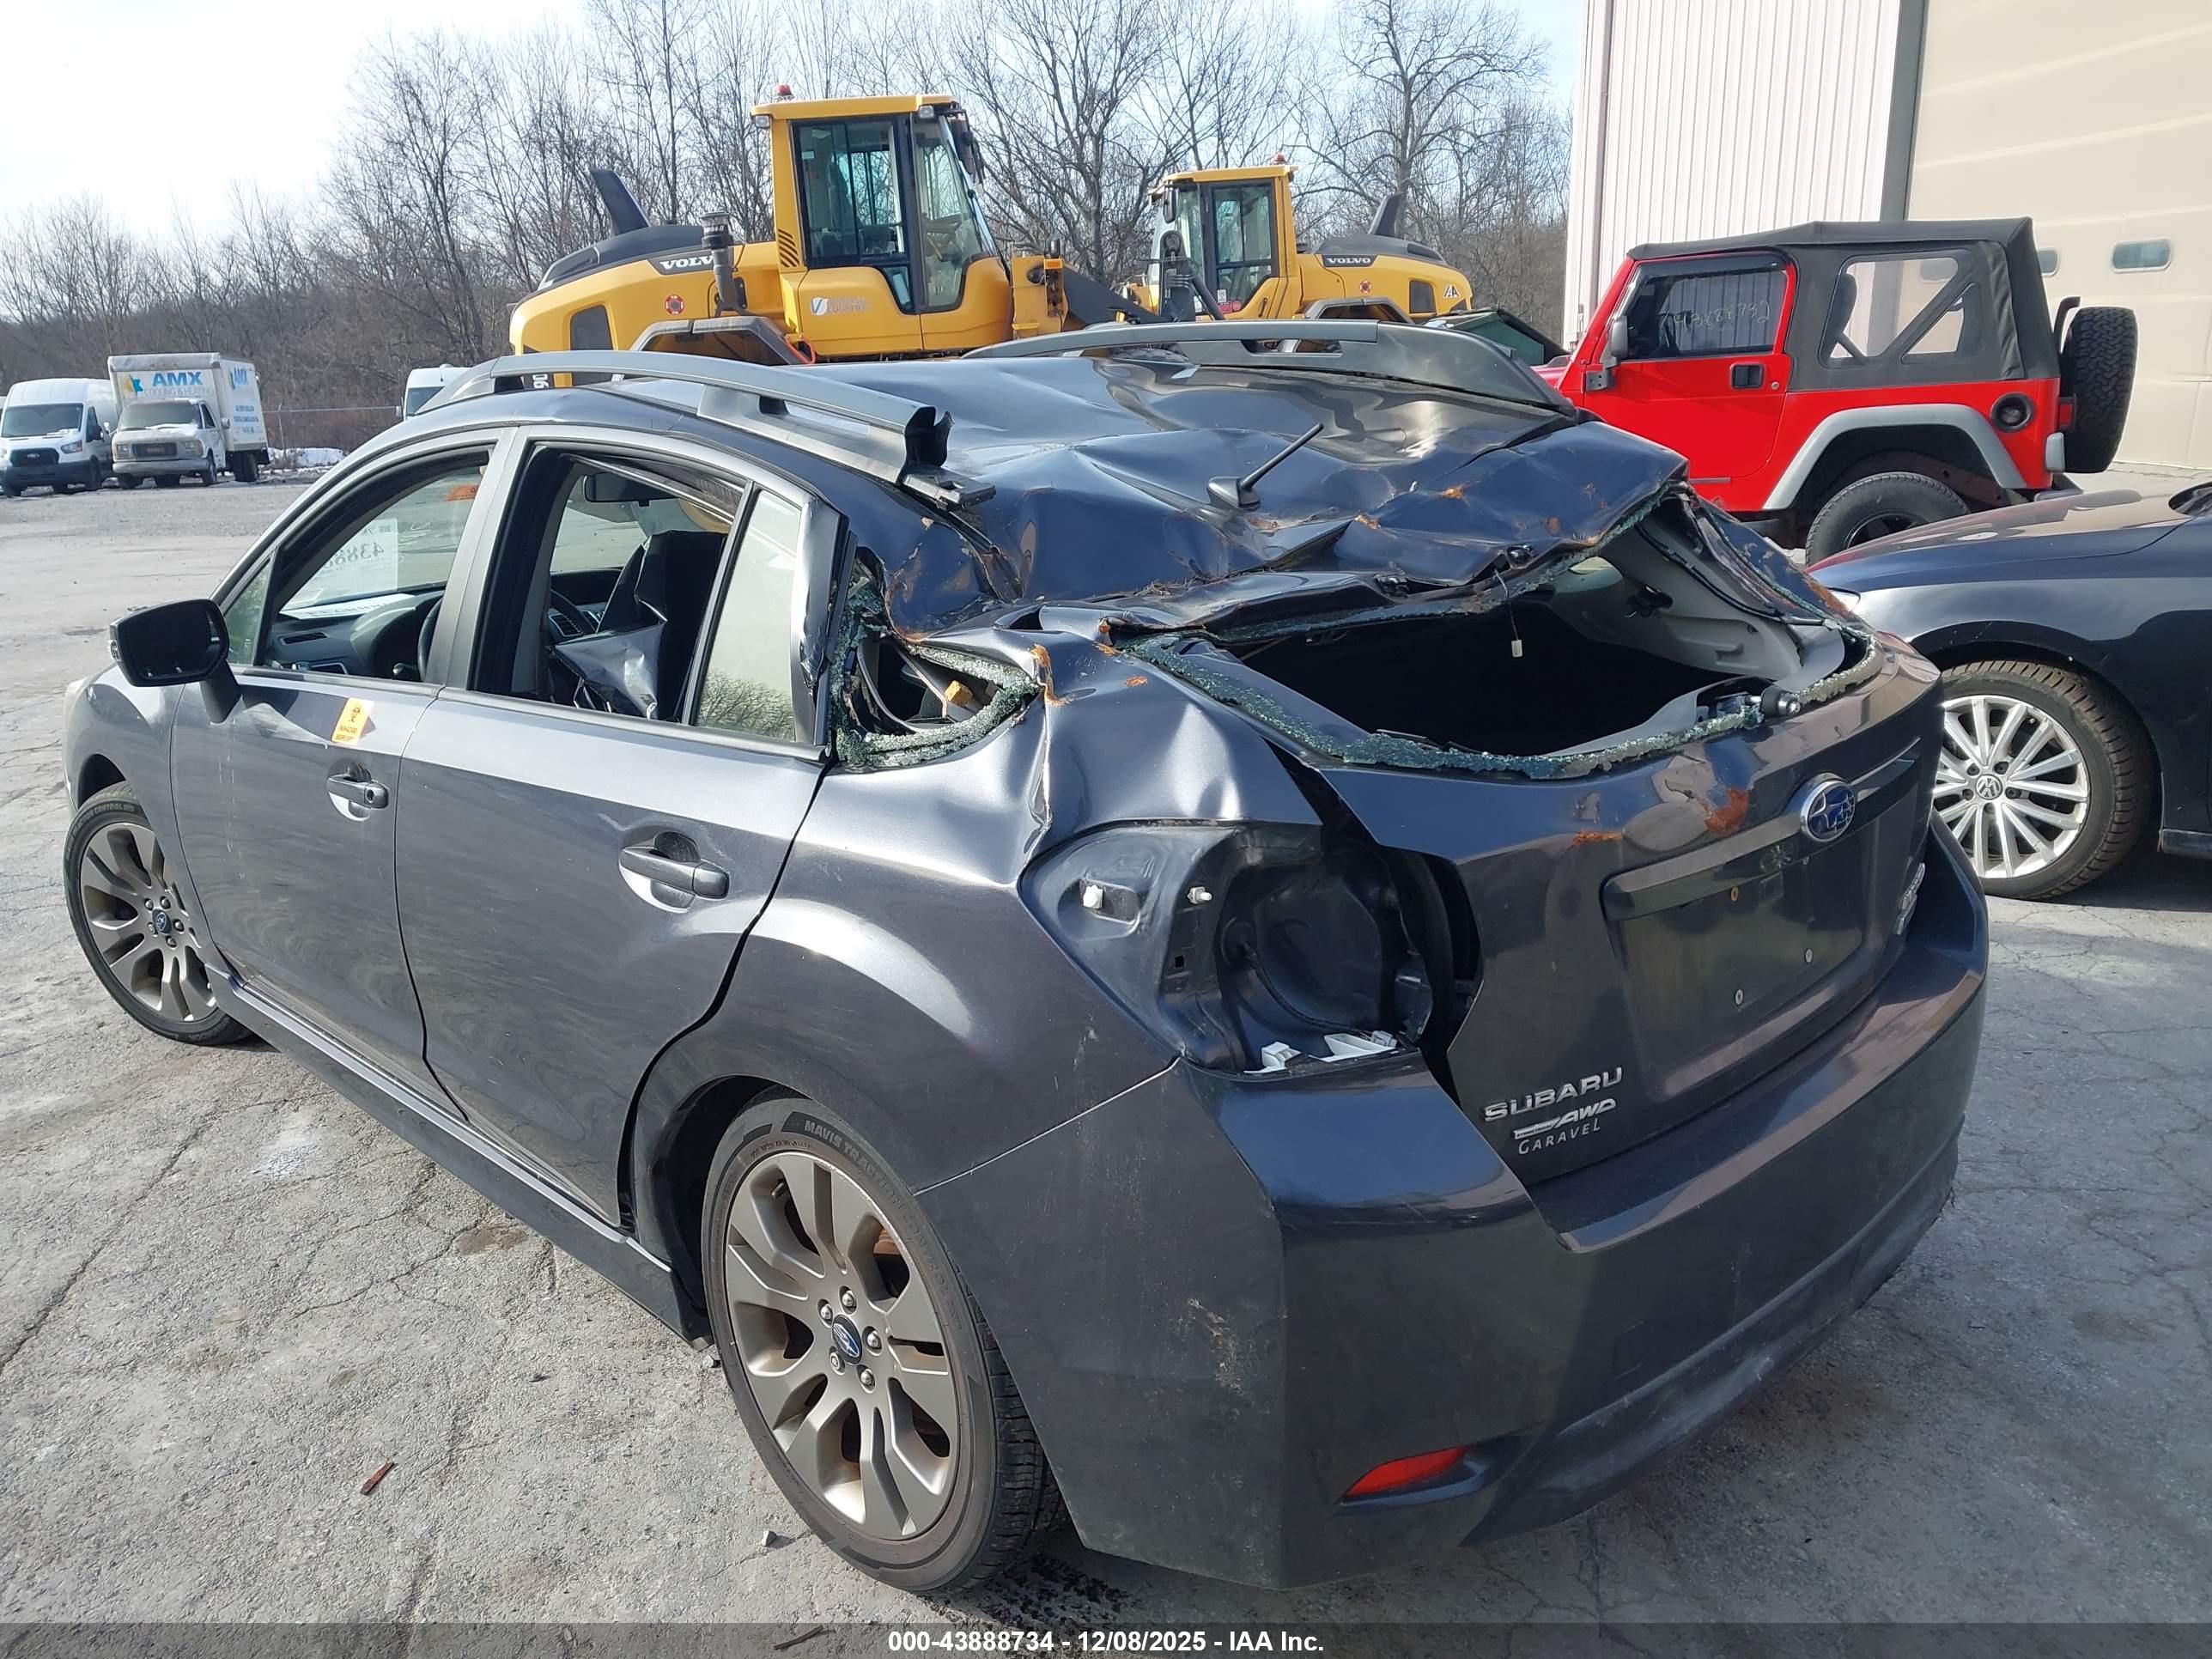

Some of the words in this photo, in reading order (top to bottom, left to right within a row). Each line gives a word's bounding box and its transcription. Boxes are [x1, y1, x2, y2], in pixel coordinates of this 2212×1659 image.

[660, 255, 714, 270] VOLV
[153, 371, 203, 386] AMX
[234, 368, 248, 386] AMX
[1484, 1066, 1623, 1122] SUBARU
[1554, 1098, 1617, 1129] AWD
[804, 1119, 842, 1148] MAVIS
[1517, 1117, 1601, 1155] GARAVEL
